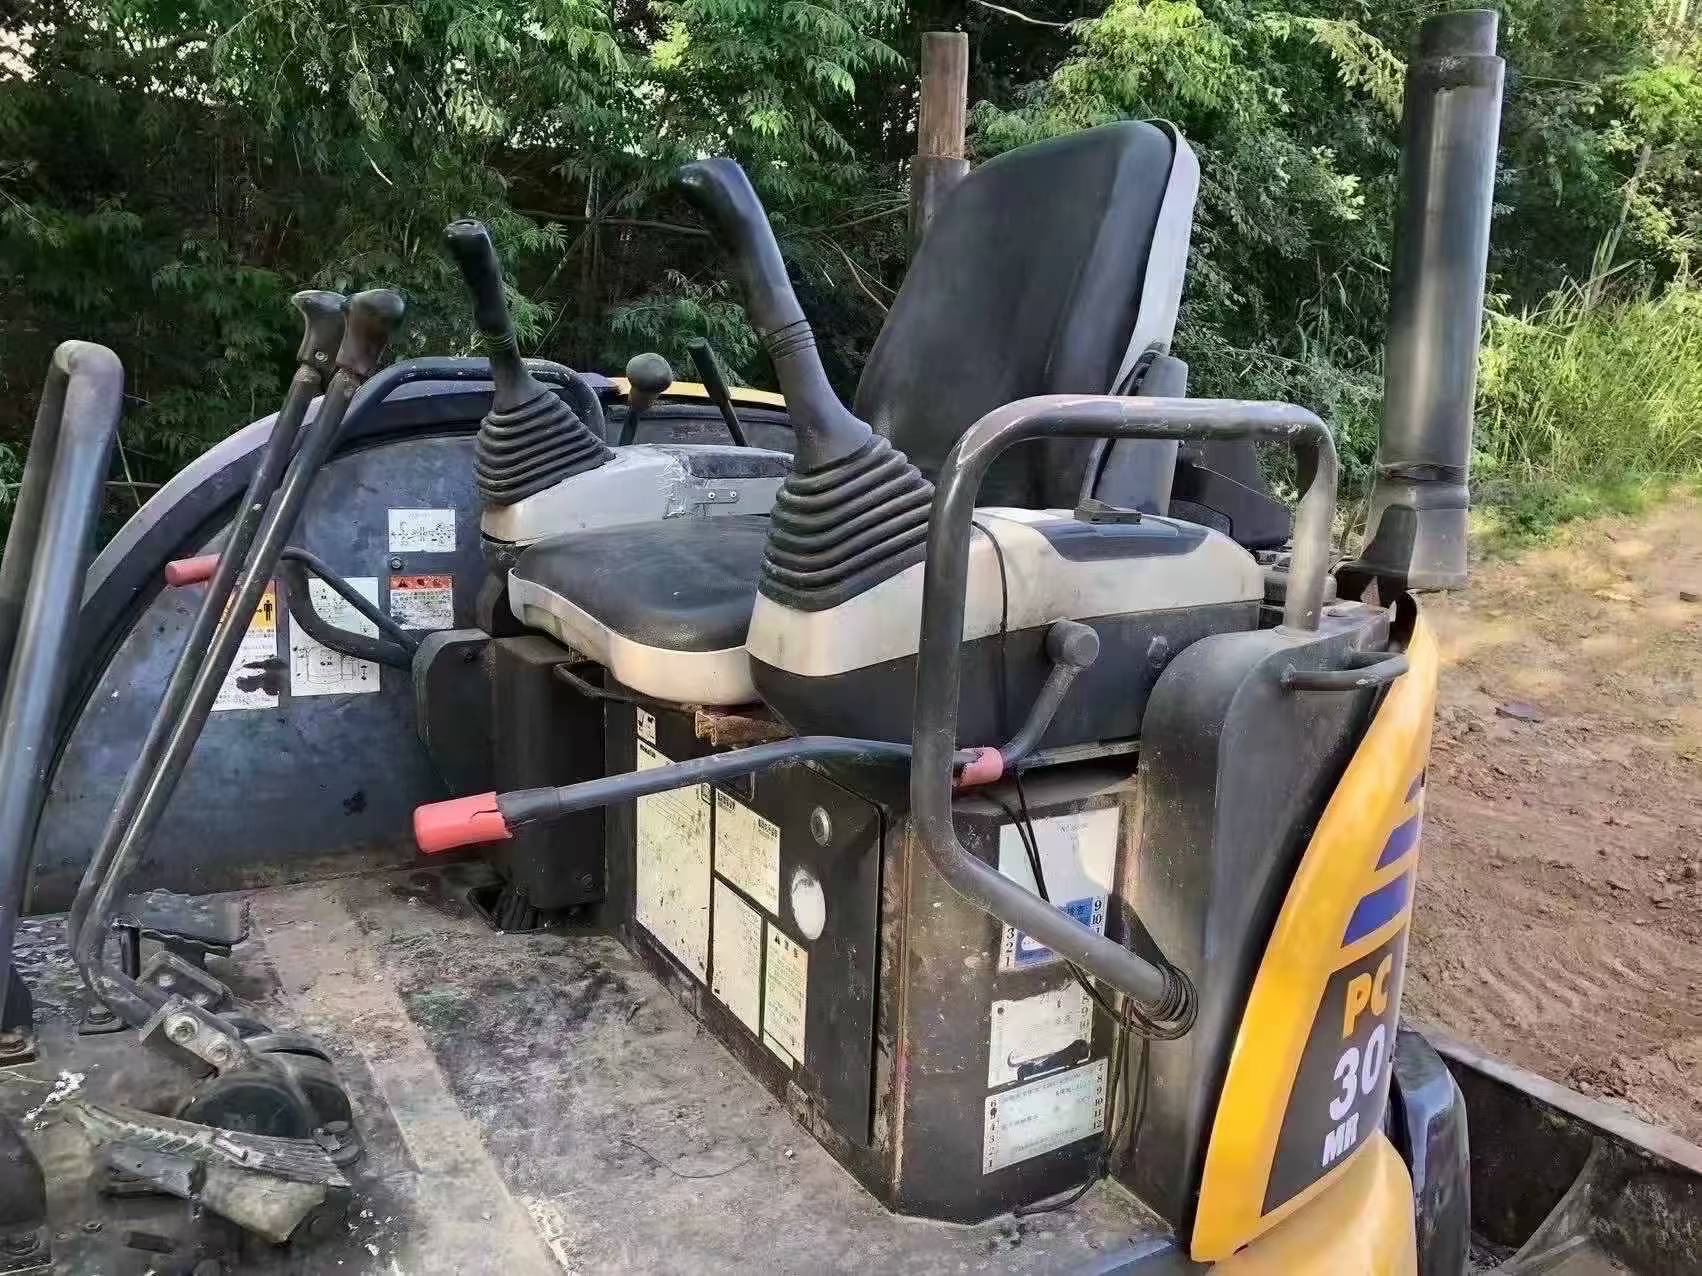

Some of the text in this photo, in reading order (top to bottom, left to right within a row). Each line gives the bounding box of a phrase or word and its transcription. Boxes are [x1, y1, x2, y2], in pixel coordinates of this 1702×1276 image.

[1094, 899, 1102, 911] 9
[1092, 913, 1102, 925] 10
[1006, 927, 1015, 940] 3
[1005, 941, 1014, 953] 2
[1343, 953, 1393, 1039] PC
[1329, 1024, 1386, 1121] 30
